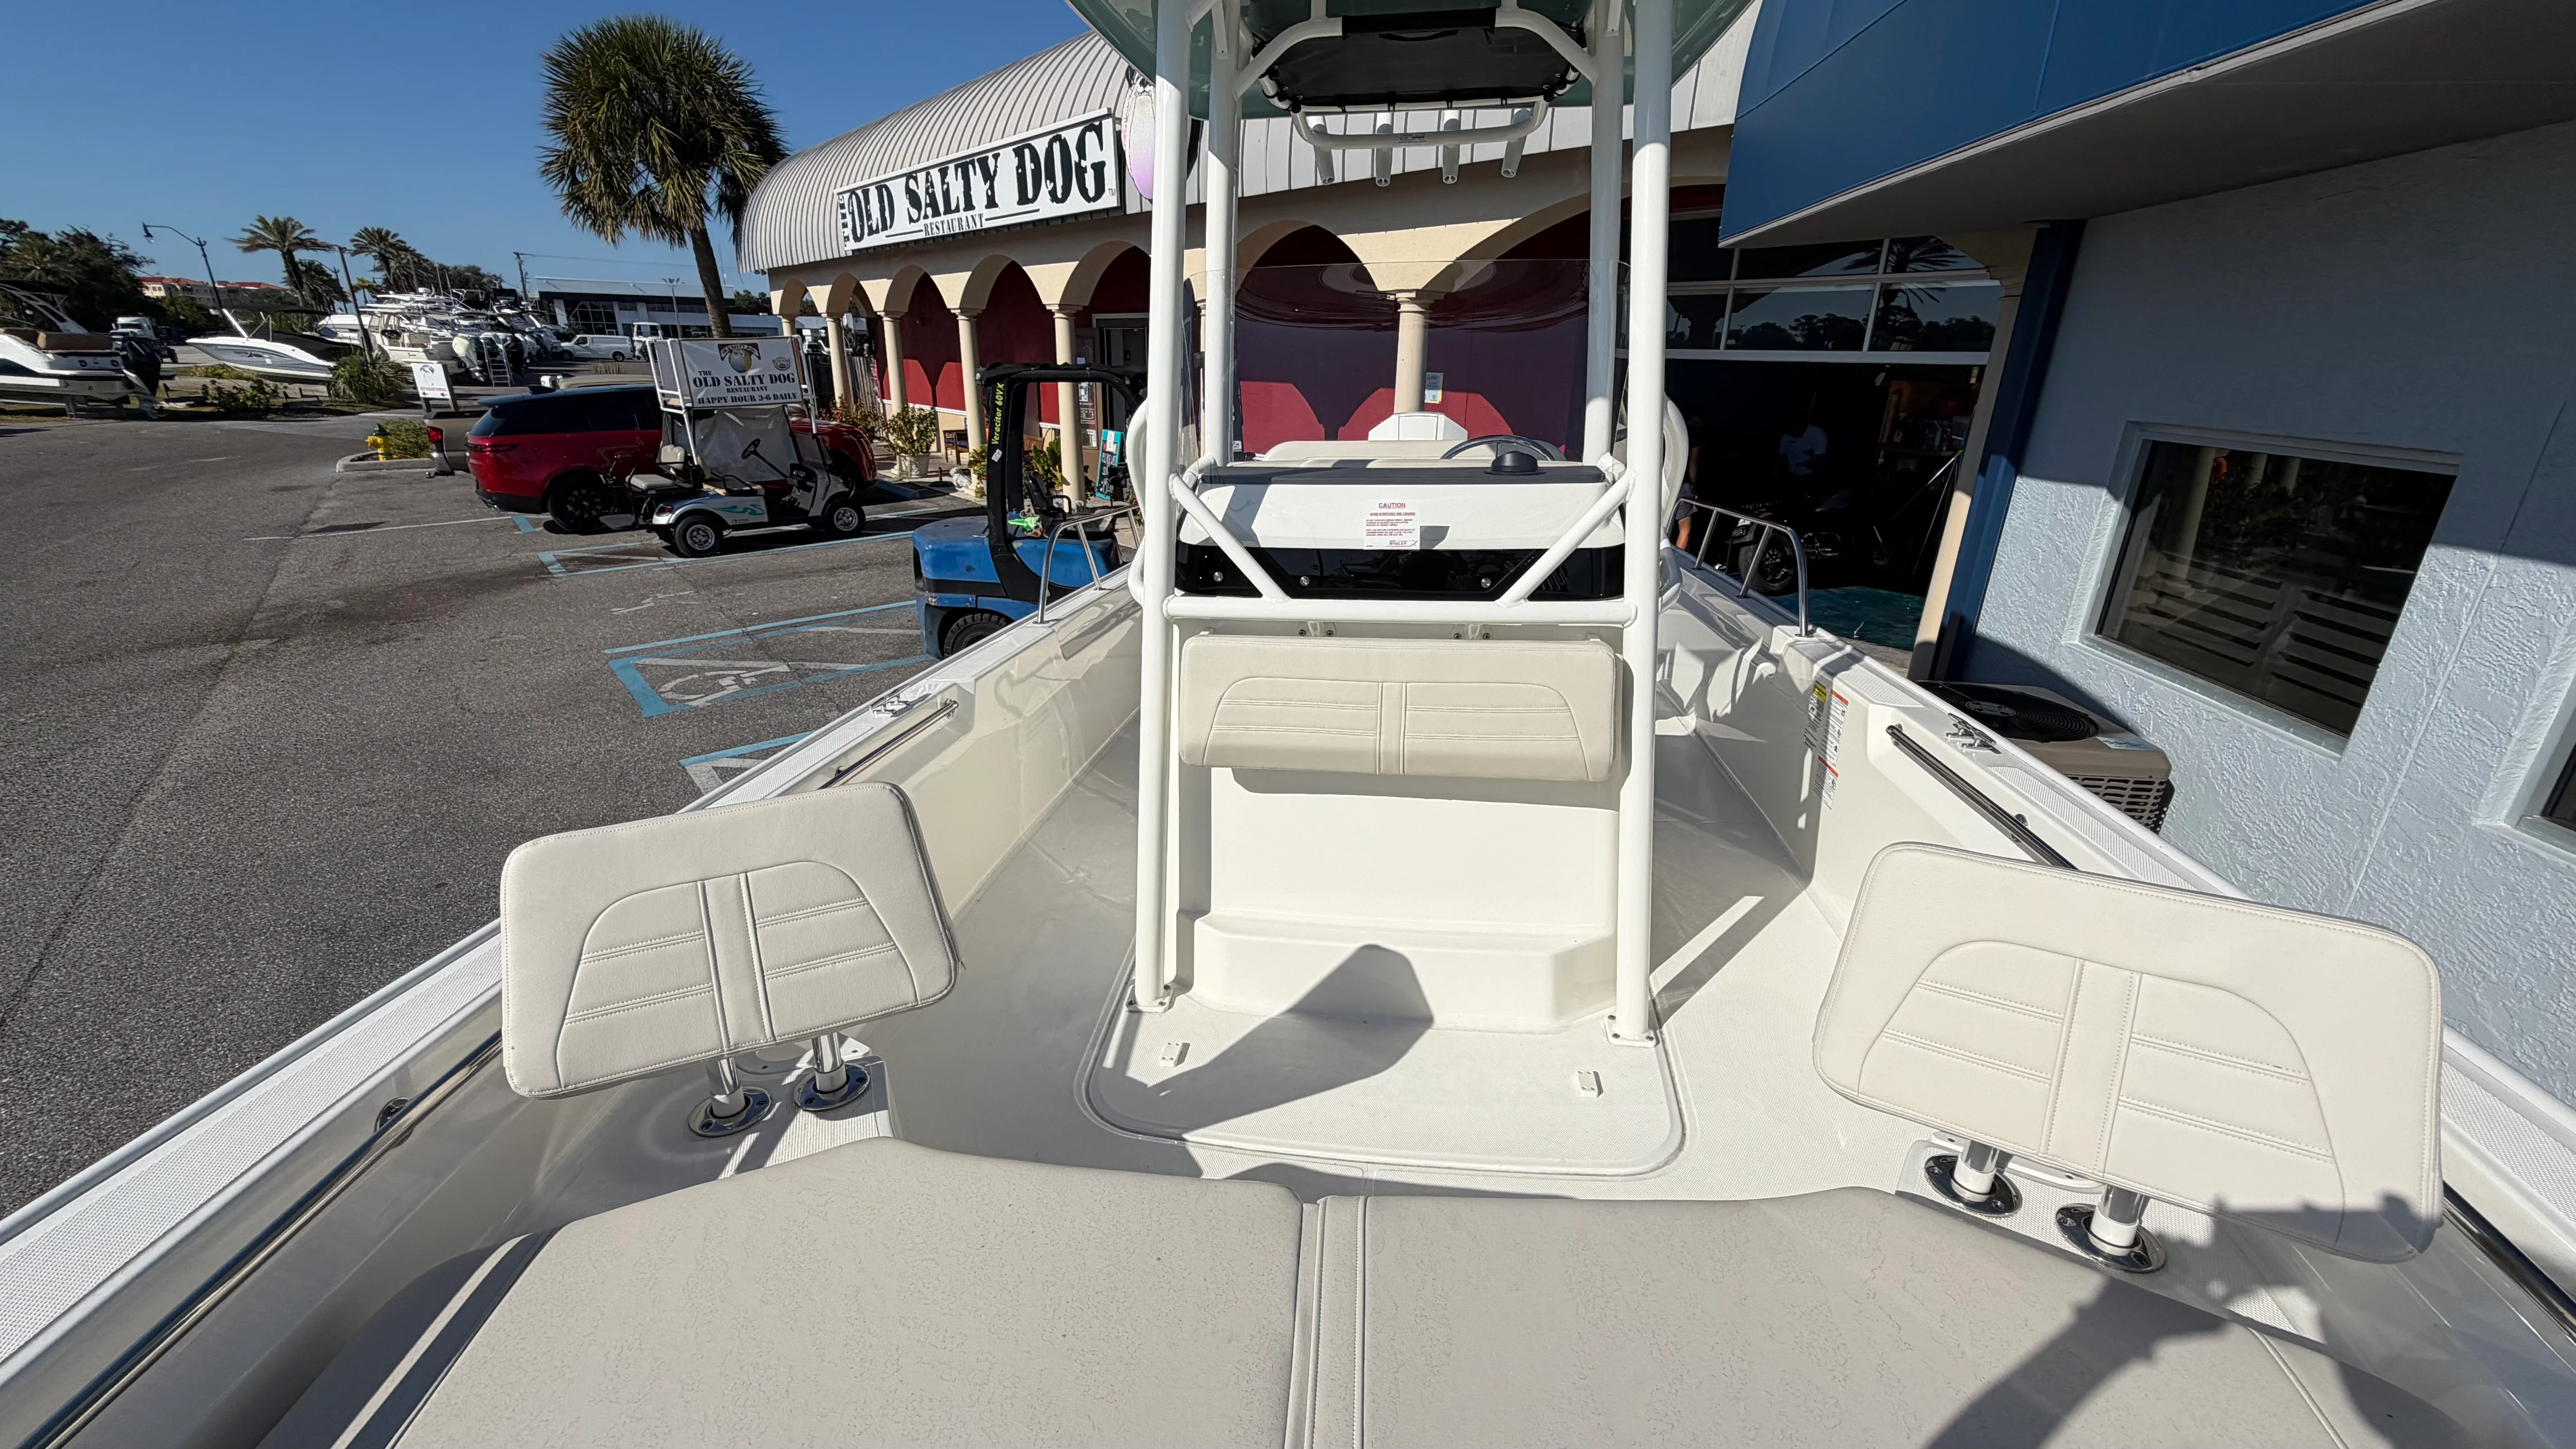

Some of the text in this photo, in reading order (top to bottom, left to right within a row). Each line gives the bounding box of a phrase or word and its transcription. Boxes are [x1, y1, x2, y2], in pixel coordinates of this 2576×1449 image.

[848, 184, 895, 244] OLD
[905, 152, 1001, 225] SALTY
[1012, 120, 1107, 206] DOG
[923, 213, 984, 237] RESTAURANT
[693, 373, 795, 388] OLD SALTY DOG
[698, 396, 728, 404] HAPPY
[731, 395, 756, 403] HOUR
[995, 382, 1005, 406] 60VX
[991, 407, 1003, 445] Veracitor
